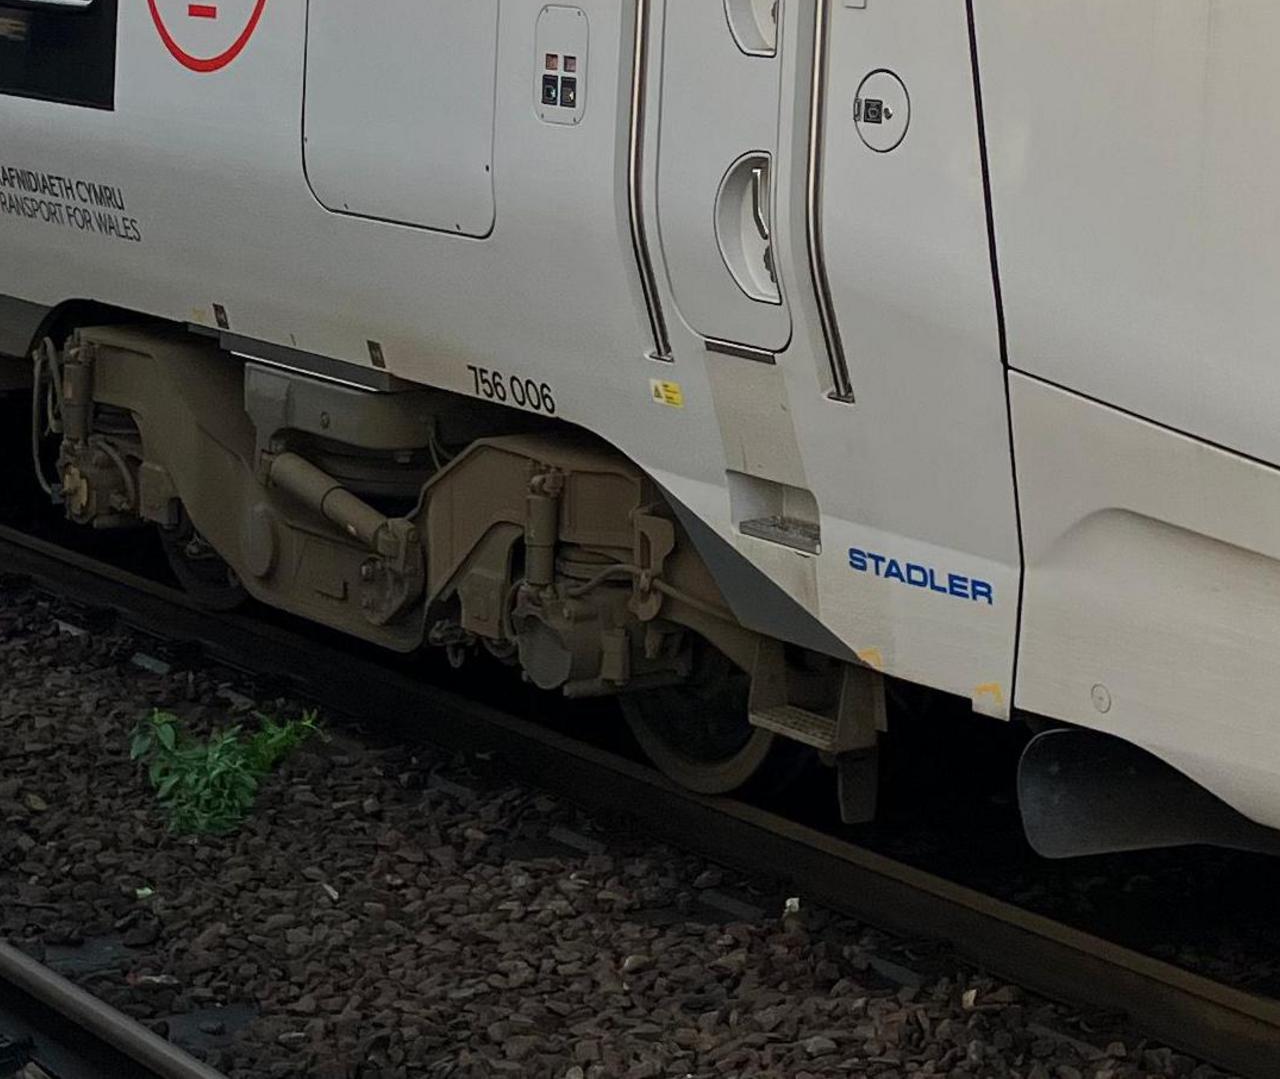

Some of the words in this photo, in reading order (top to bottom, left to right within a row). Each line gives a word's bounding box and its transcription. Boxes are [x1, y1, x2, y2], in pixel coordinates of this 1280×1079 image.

[75, 180, 125, 211] CYMRU
[65, 204, 95, 232] FOR
[92, 210, 142, 242] WALES
[466, 364, 507, 402] 756
[509, 375, 555, 414] 006
[848, 547, 994, 606] STADLER
